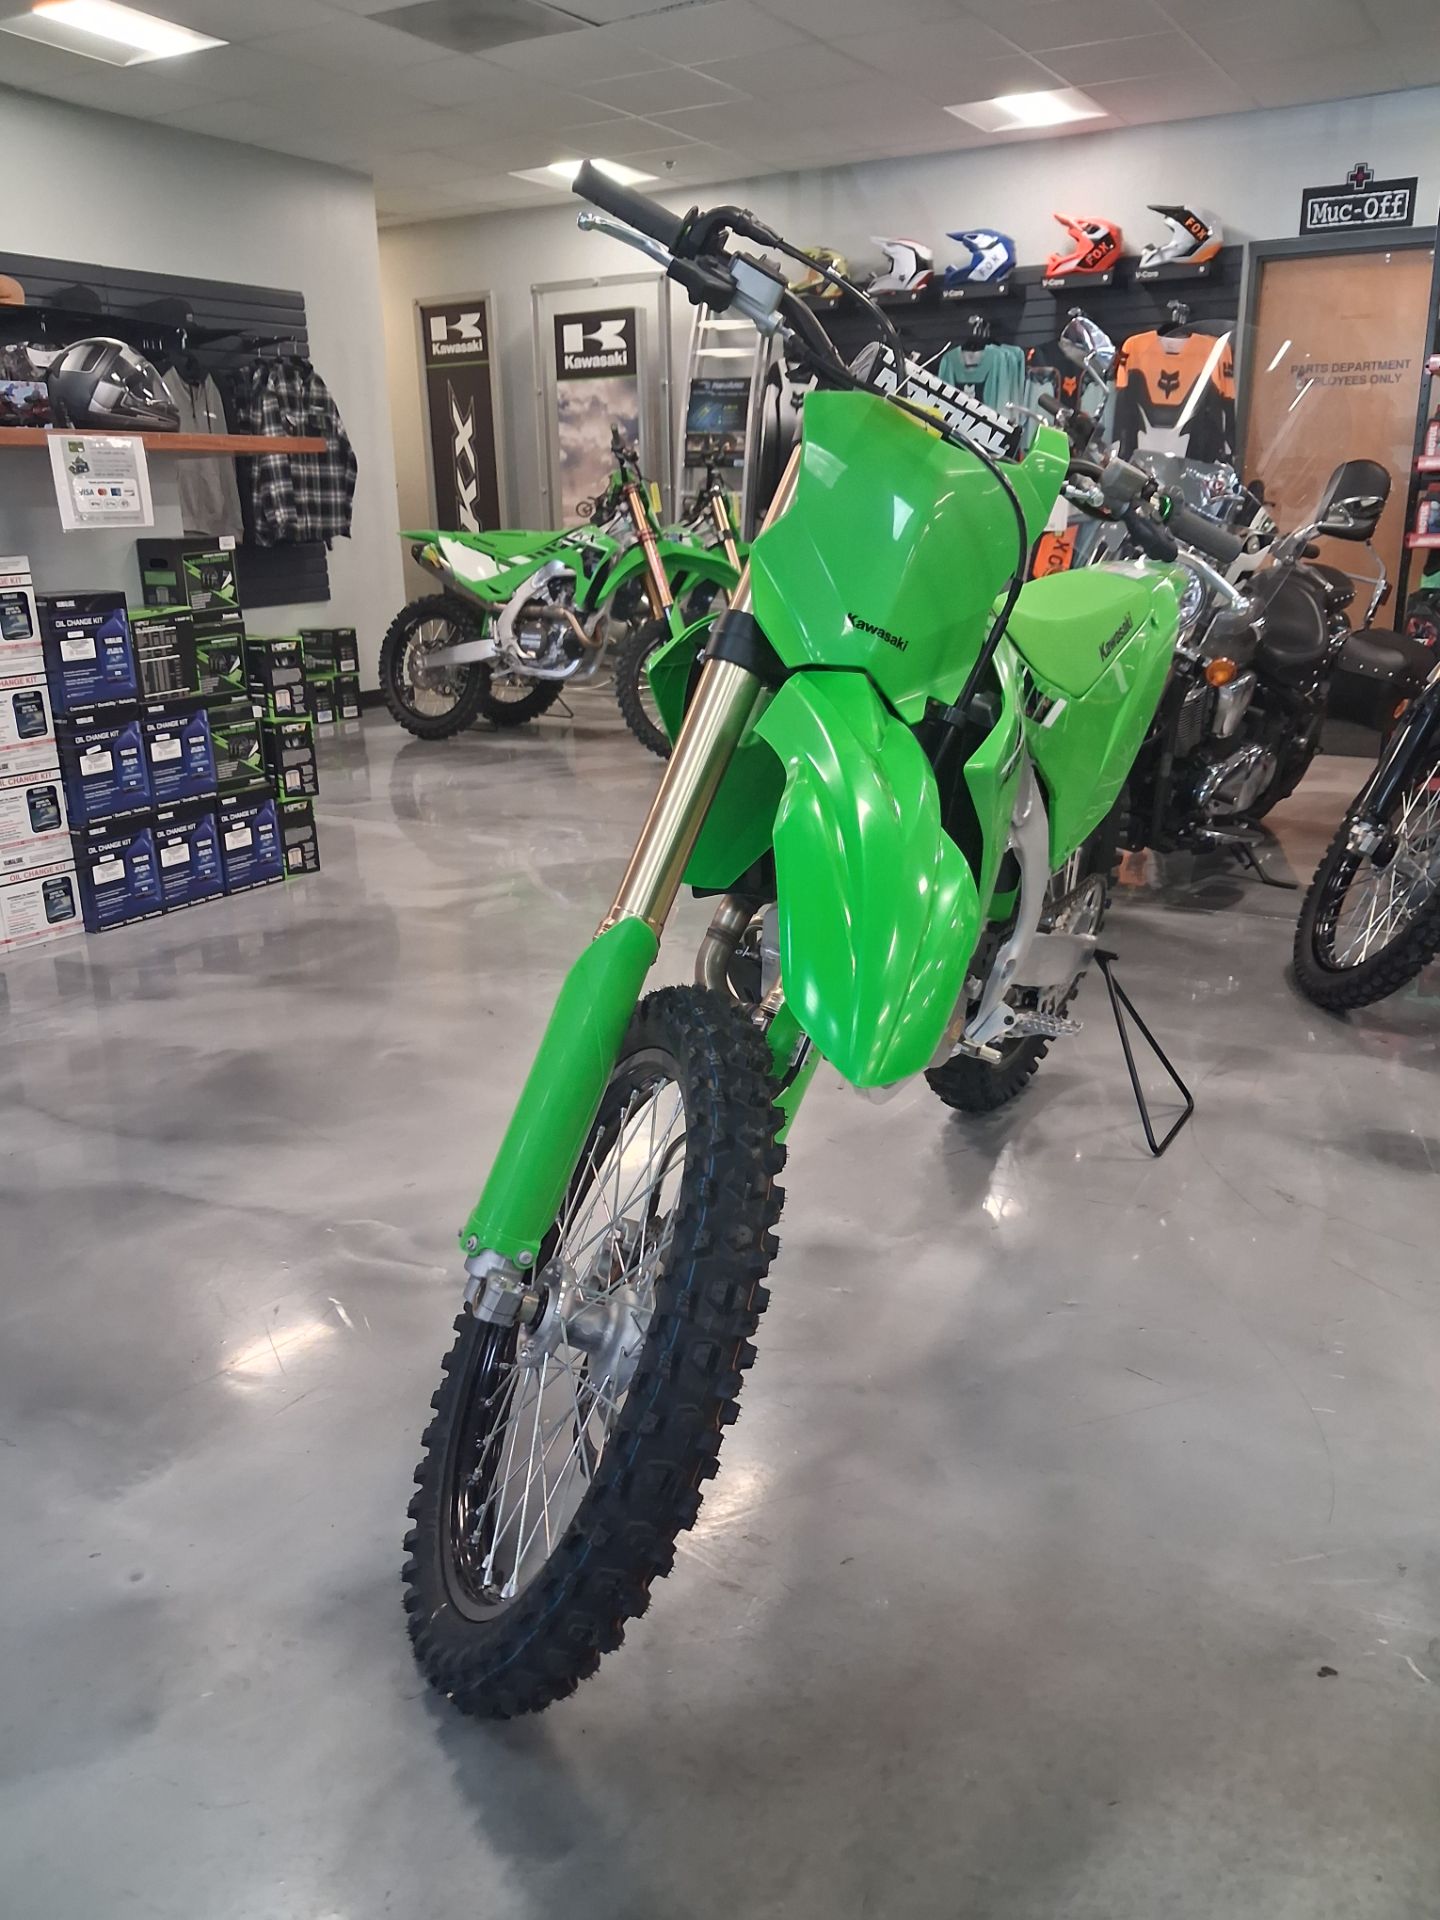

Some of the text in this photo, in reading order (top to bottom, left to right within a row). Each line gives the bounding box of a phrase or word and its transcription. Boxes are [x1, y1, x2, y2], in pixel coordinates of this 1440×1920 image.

[1311, 192, 1405, 224] Muc-Off
[1184, 216, 1207, 242] FOX
[1086, 241, 1110, 265] FOX
[979, 254, 999, 277] FOX
[431, 338, 483, 356] Kawasaki
[564, 350, 627, 370] Kawasaki
[1290, 359, 1412, 375] PARTS DEPARTMENT
[1369, 373, 1402, 384] ONLY
[55, 616, 103, 628] OIL CHANGE KIT
[847, 612, 909, 652] Kawasaki
[1098, 611, 1133, 662] Kawasaki
[156, 720, 179, 730] CHANGE
[75, 729, 120, 744] OIL CHANGE KIT
[8, 774, 39, 786] CHANGE
[230, 810, 249, 821] CHANGE
[166, 825, 188, 836] CHANGE
[87, 838, 131, 855] OIL CHANGE KIT
[9, 863, 66, 882] OIL CHANGE KIT
